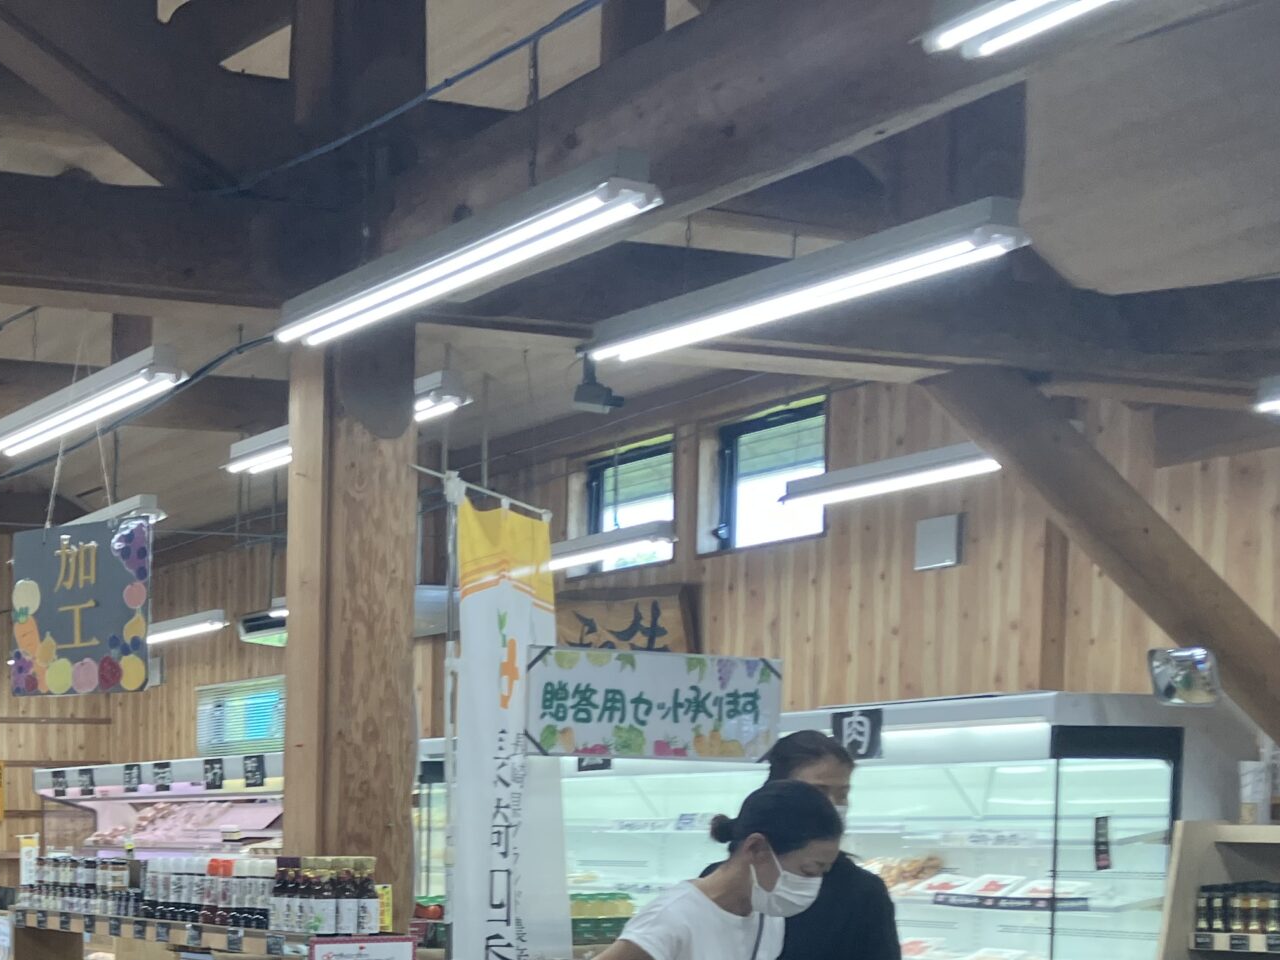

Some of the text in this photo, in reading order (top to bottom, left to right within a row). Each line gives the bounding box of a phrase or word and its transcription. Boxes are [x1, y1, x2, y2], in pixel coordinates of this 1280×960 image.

[54, 540, 100, 650] 加工
[540, 681, 761, 726] 贈答用セット承ります
[842, 710, 871, 755] 肉
